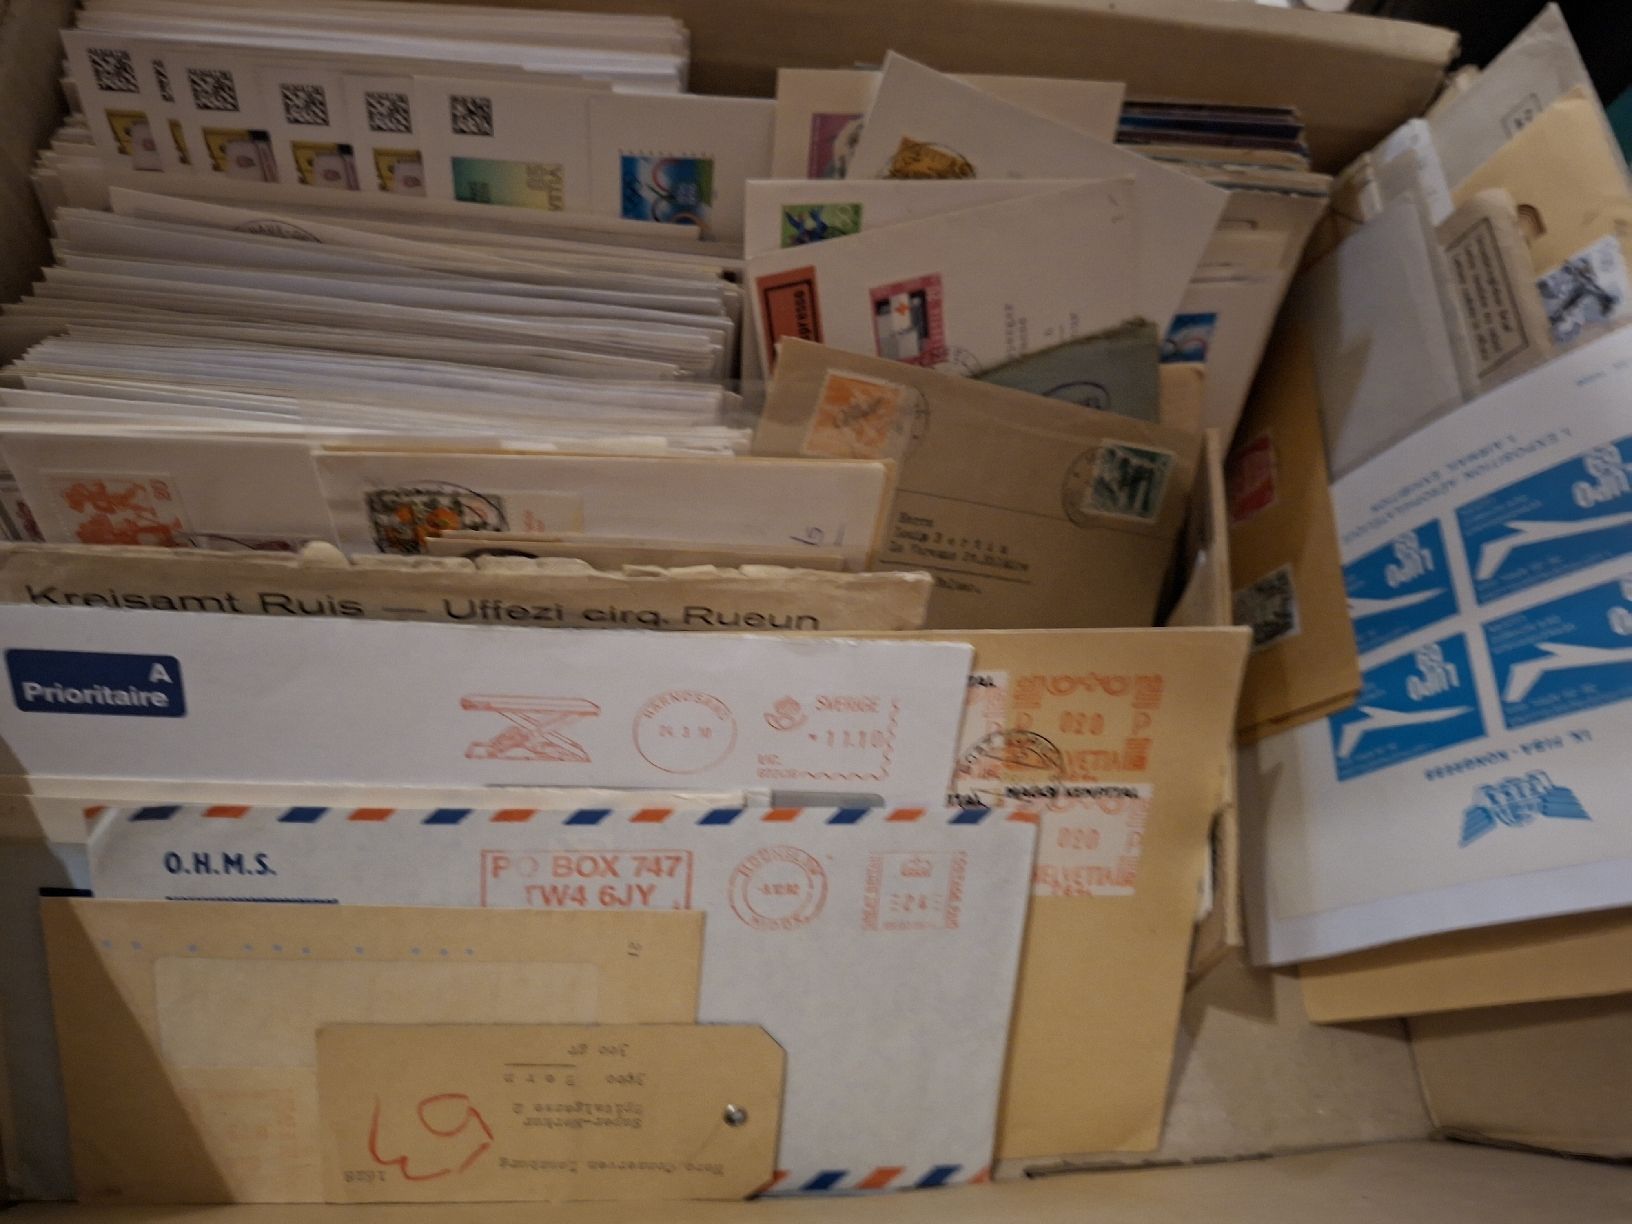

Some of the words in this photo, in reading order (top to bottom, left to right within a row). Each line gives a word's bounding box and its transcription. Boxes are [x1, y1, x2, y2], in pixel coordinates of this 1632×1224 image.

[25, 584, 240, 614] Kreisamt
[256, 591, 366, 617] Ruis
[441, 599, 565, 622] Uffezi
[683, 606, 821, 631] Rueun
[148, 662, 173, 684] A
[22, 682, 169, 708] Prioritaire
[164, 851, 276, 876] O.H.M.S.
[551, 856, 619, 879] BOX
[632, 856, 683, 879] 747
[599, 884, 658, 908] 6JY
